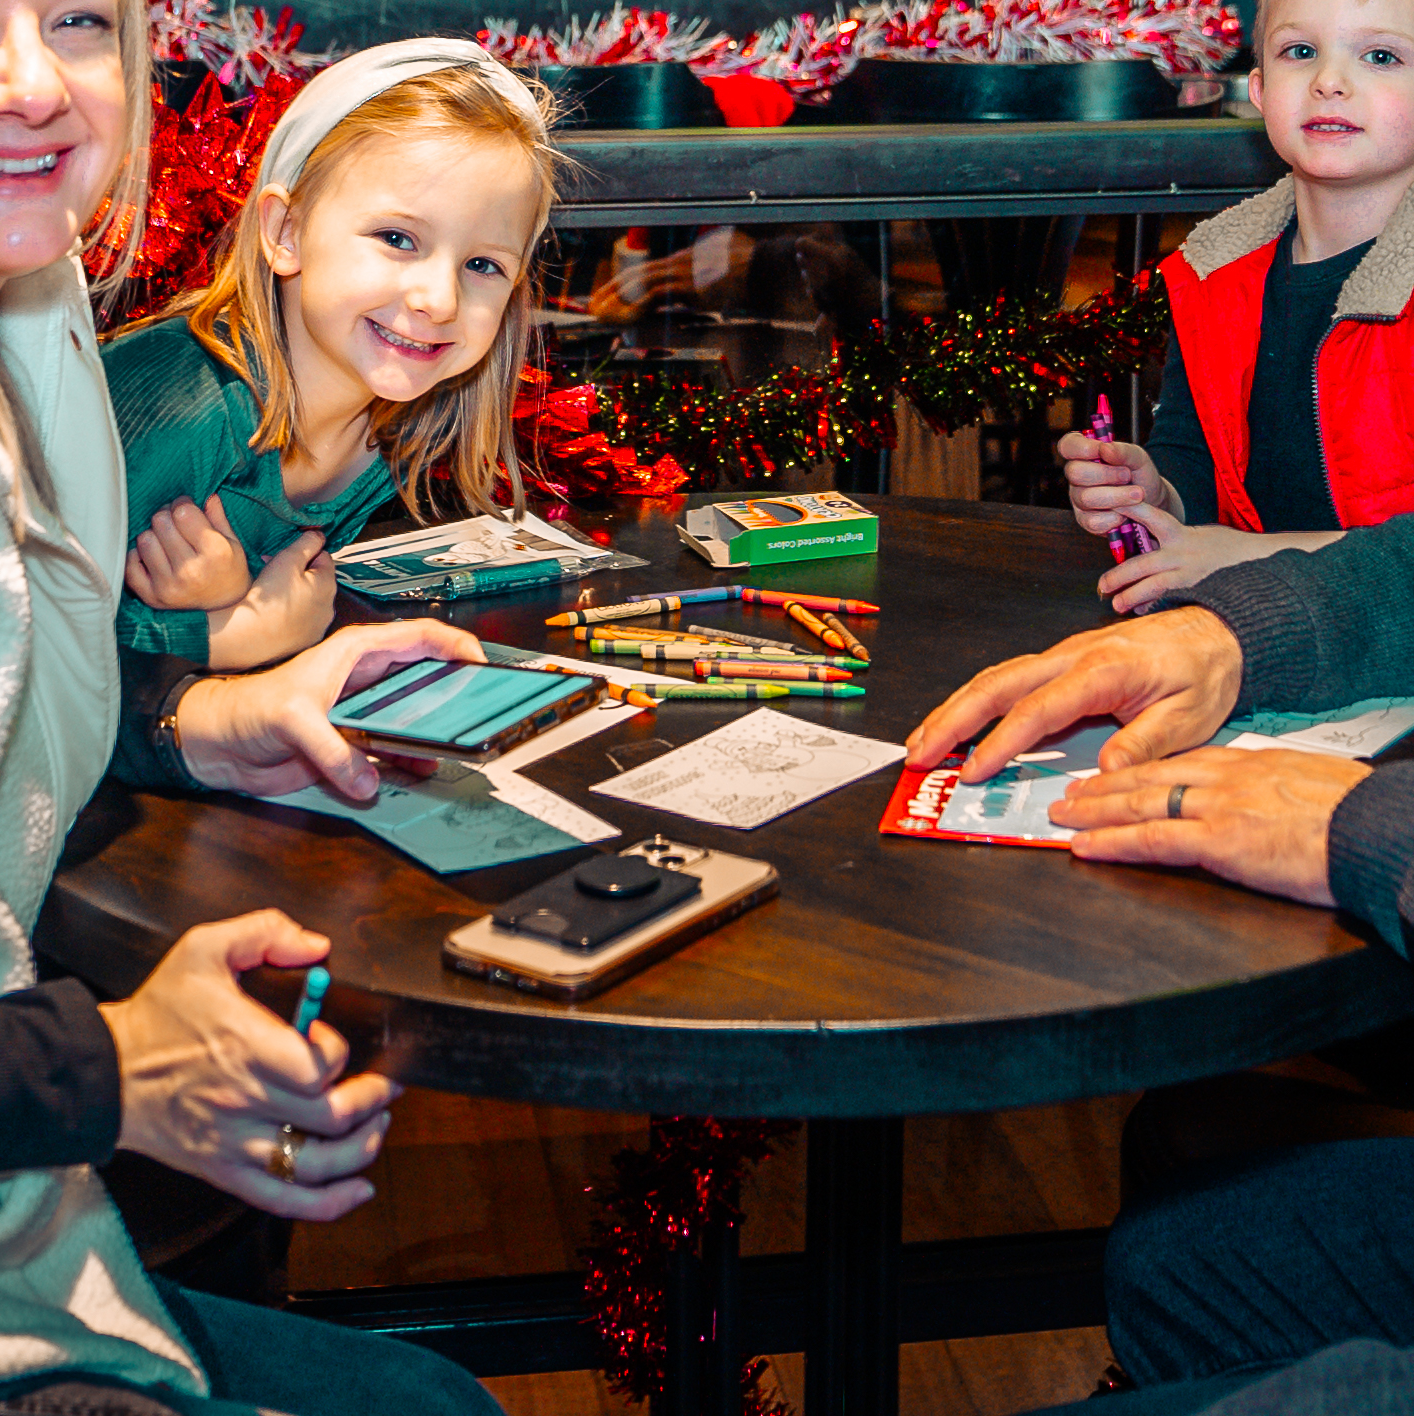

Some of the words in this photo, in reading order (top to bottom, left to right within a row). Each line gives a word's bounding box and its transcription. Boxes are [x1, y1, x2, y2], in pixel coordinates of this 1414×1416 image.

[796, 536, 836, 548] Assorted
[835, 532, 864, 543] Bright
[766, 540, 796, 550] Colors
[907, 769, 961, 819] Merry
